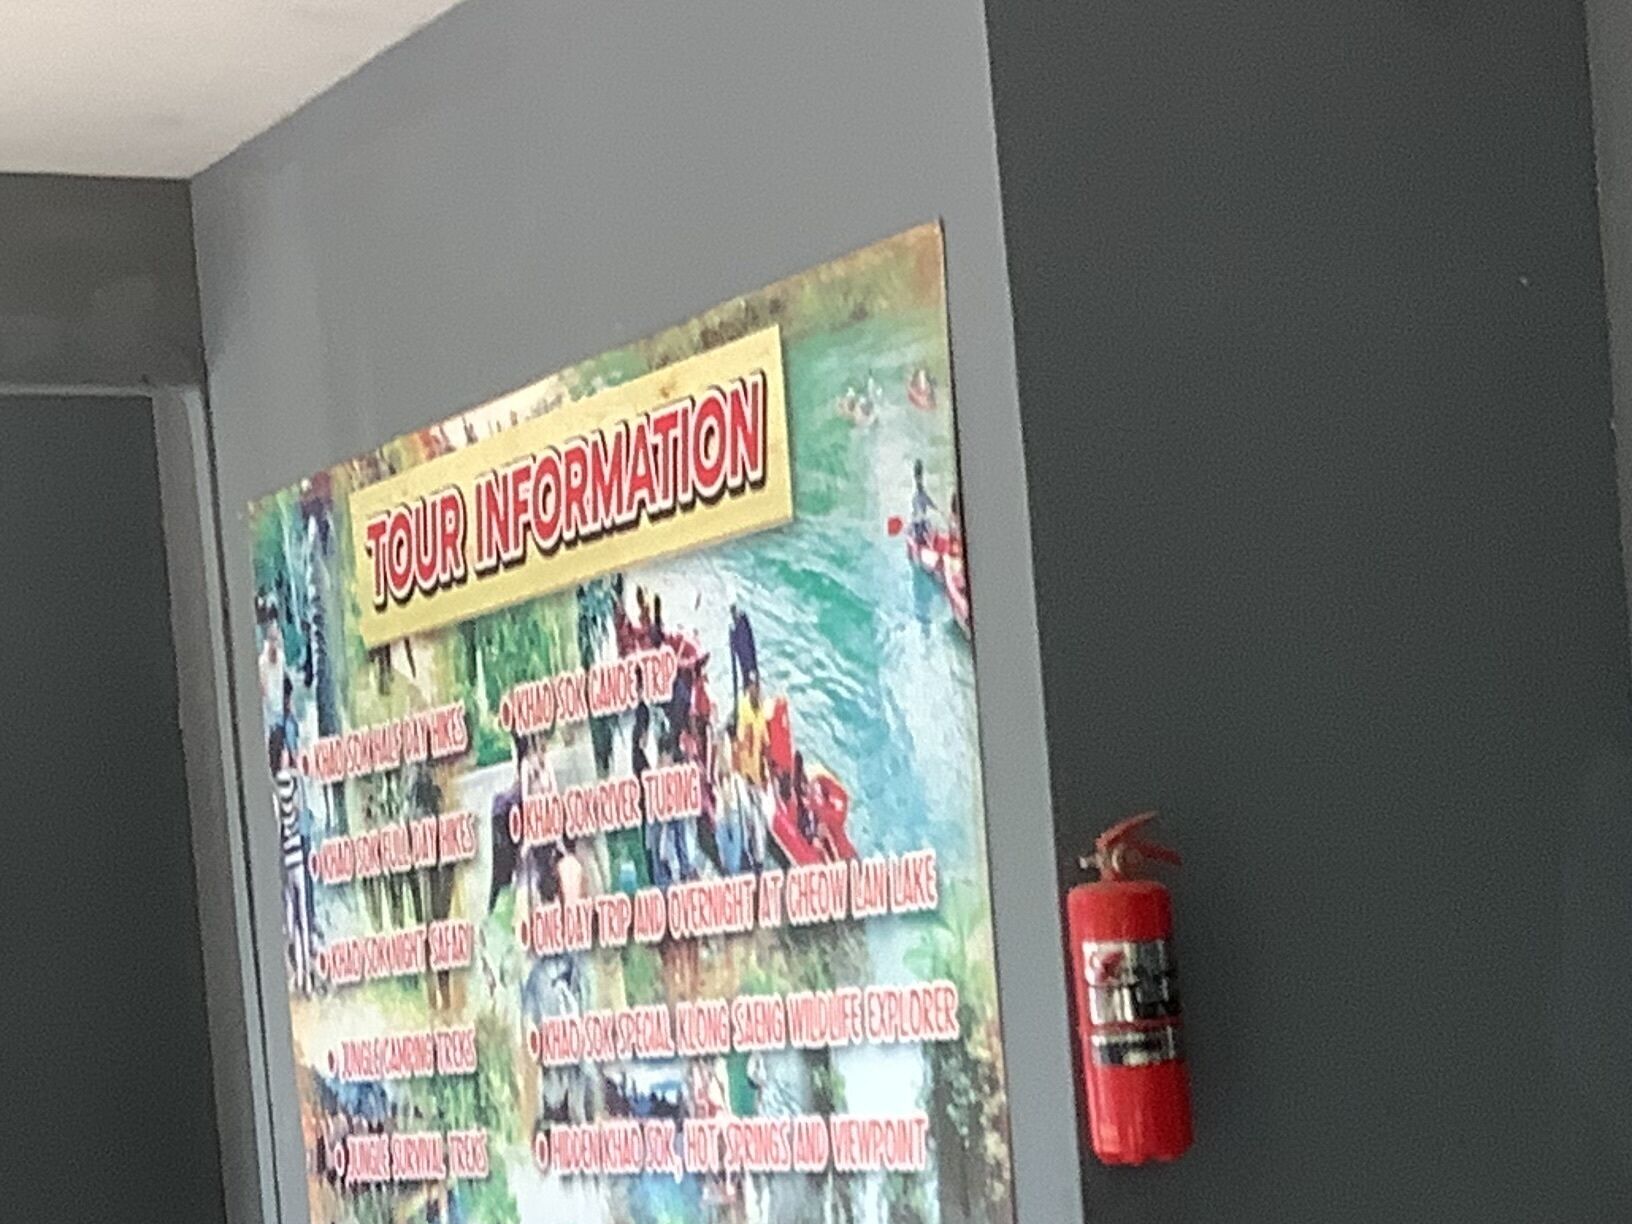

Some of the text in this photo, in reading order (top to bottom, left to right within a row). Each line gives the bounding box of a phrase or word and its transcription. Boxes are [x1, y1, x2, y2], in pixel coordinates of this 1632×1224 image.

[366, 373, 767, 611] TOUR INFORMATION
[514, 648, 677, 734] KHAO SOK CANOE TRIP
[524, 764, 701, 845] KHAO SOK RIVER TUBING
[321, 837, 353, 884] KHAO
[355, 830, 381, 877] SOK
[412, 816, 437, 868] DAY
[533, 849, 938, 955] ONE DAY TRIP AND OVERNIGHT AT CHEOW LAN LAKE
[541, 981, 959, 1066] KHAO SOK SPECIAL KLONG SAENG WILDLIFE EXPLORER
[551, 1124, 600, 1174] HIDDEN
[601, 1119, 644, 1172] KHAO
[684, 1119, 719, 1172] HOT
[723, 1117, 791, 1171] SPRINGS
[793, 1115, 829, 1170] AND
[830, 1114, 927, 1171] VIEWPOINT
